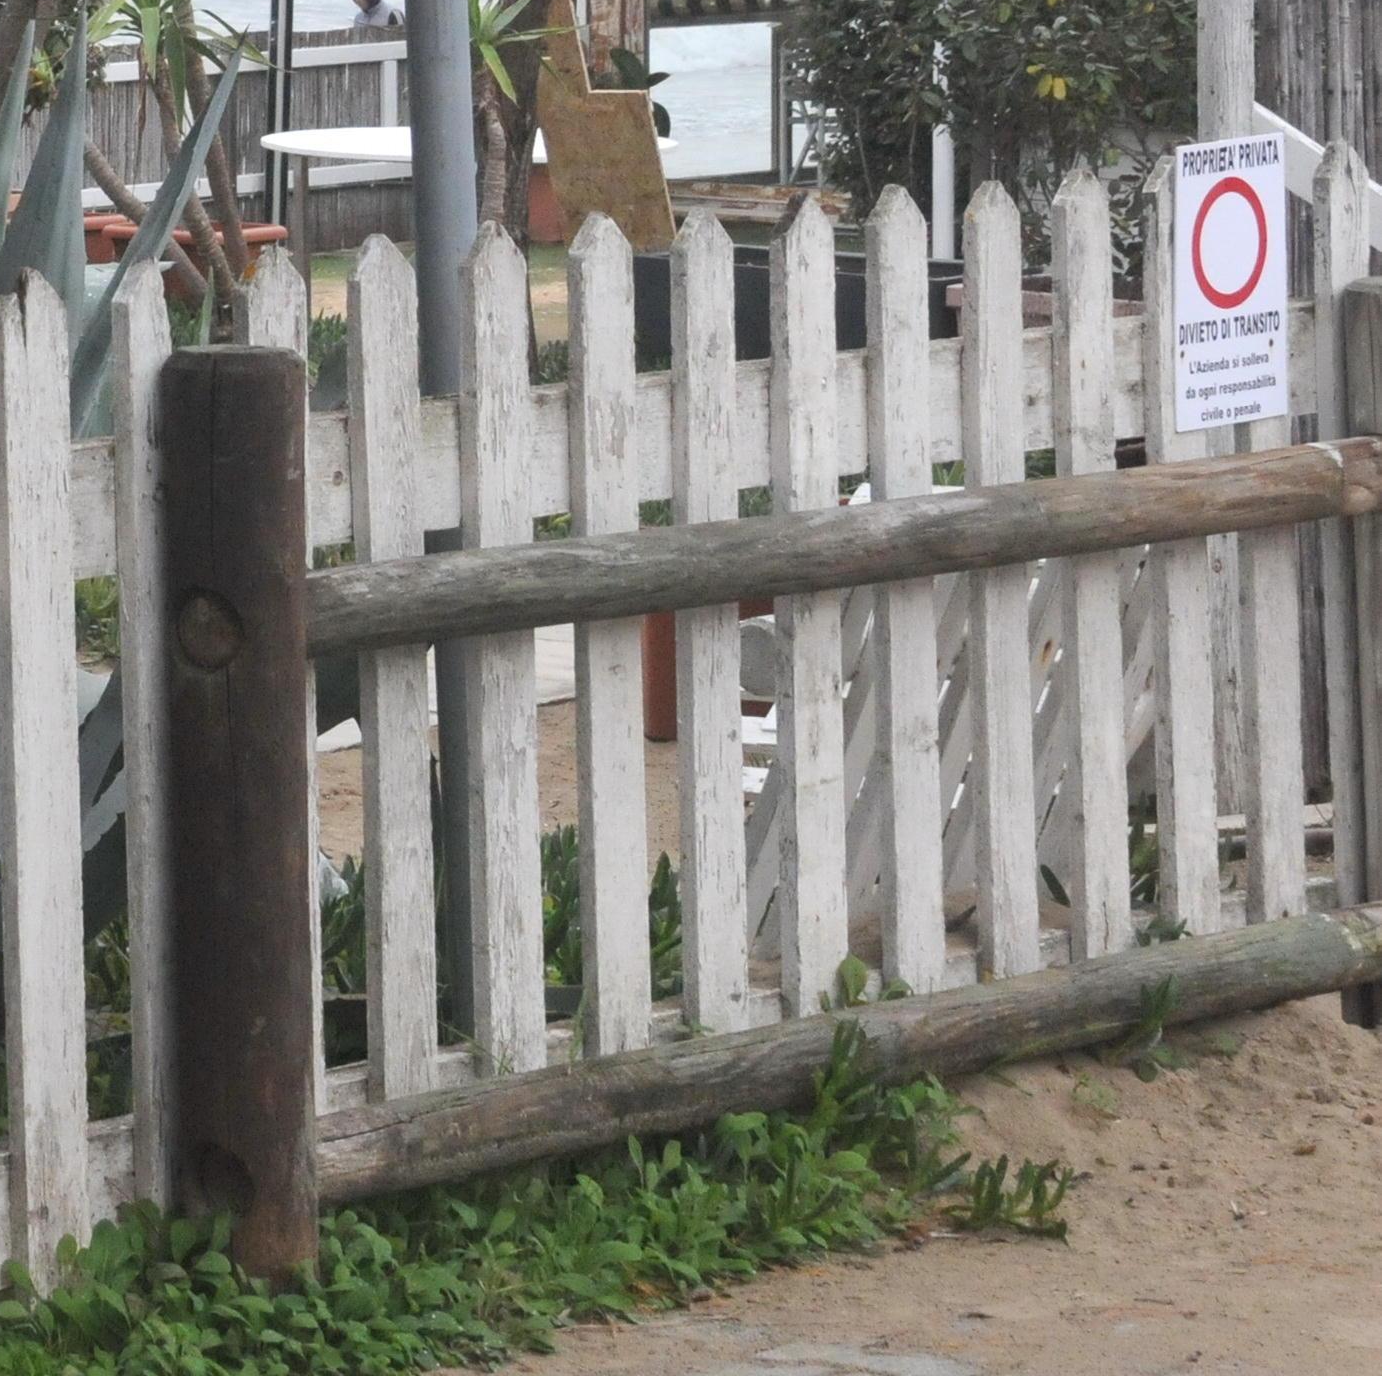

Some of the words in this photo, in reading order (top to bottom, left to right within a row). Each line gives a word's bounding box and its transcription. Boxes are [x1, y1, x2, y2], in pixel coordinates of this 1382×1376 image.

[1239, 139, 1280, 169] PRIVATA
[1179, 320, 1218, 345] DIVIETO
[1221, 317, 1231, 339] DI
[1233, 310, 1280, 338] TRANSITO
[1189, 356, 1230, 374] L'Azienda
[1232, 355, 1240, 368] si
[1242, 352, 1269, 367] solleva
[1185, 386, 1196, 400] da
[1198, 383, 1217, 400] ogni
[1201, 406, 1224, 422] civile
[1226, 408, 1232, 418] o
[1234, 401, 1262, 420] penale
